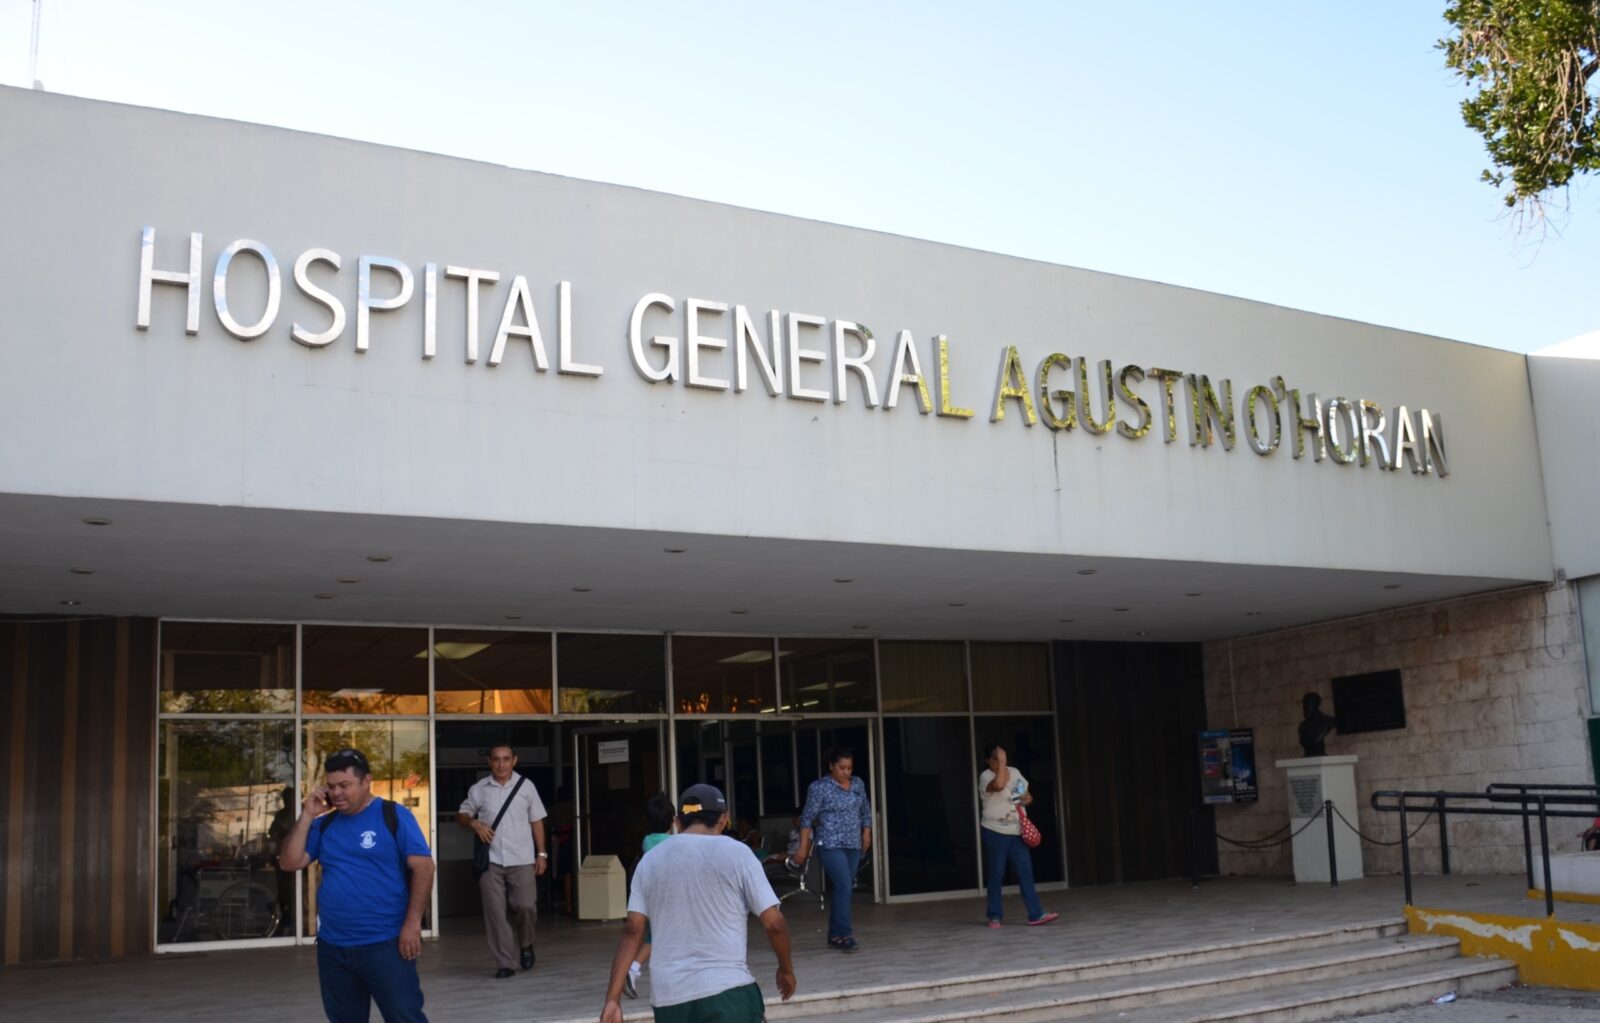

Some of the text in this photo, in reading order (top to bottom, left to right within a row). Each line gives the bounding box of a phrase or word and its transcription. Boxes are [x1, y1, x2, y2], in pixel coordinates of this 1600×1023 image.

[136, 226, 1450, 478] HOSPITAL GENERAL AGUSTIN O'HORAN
